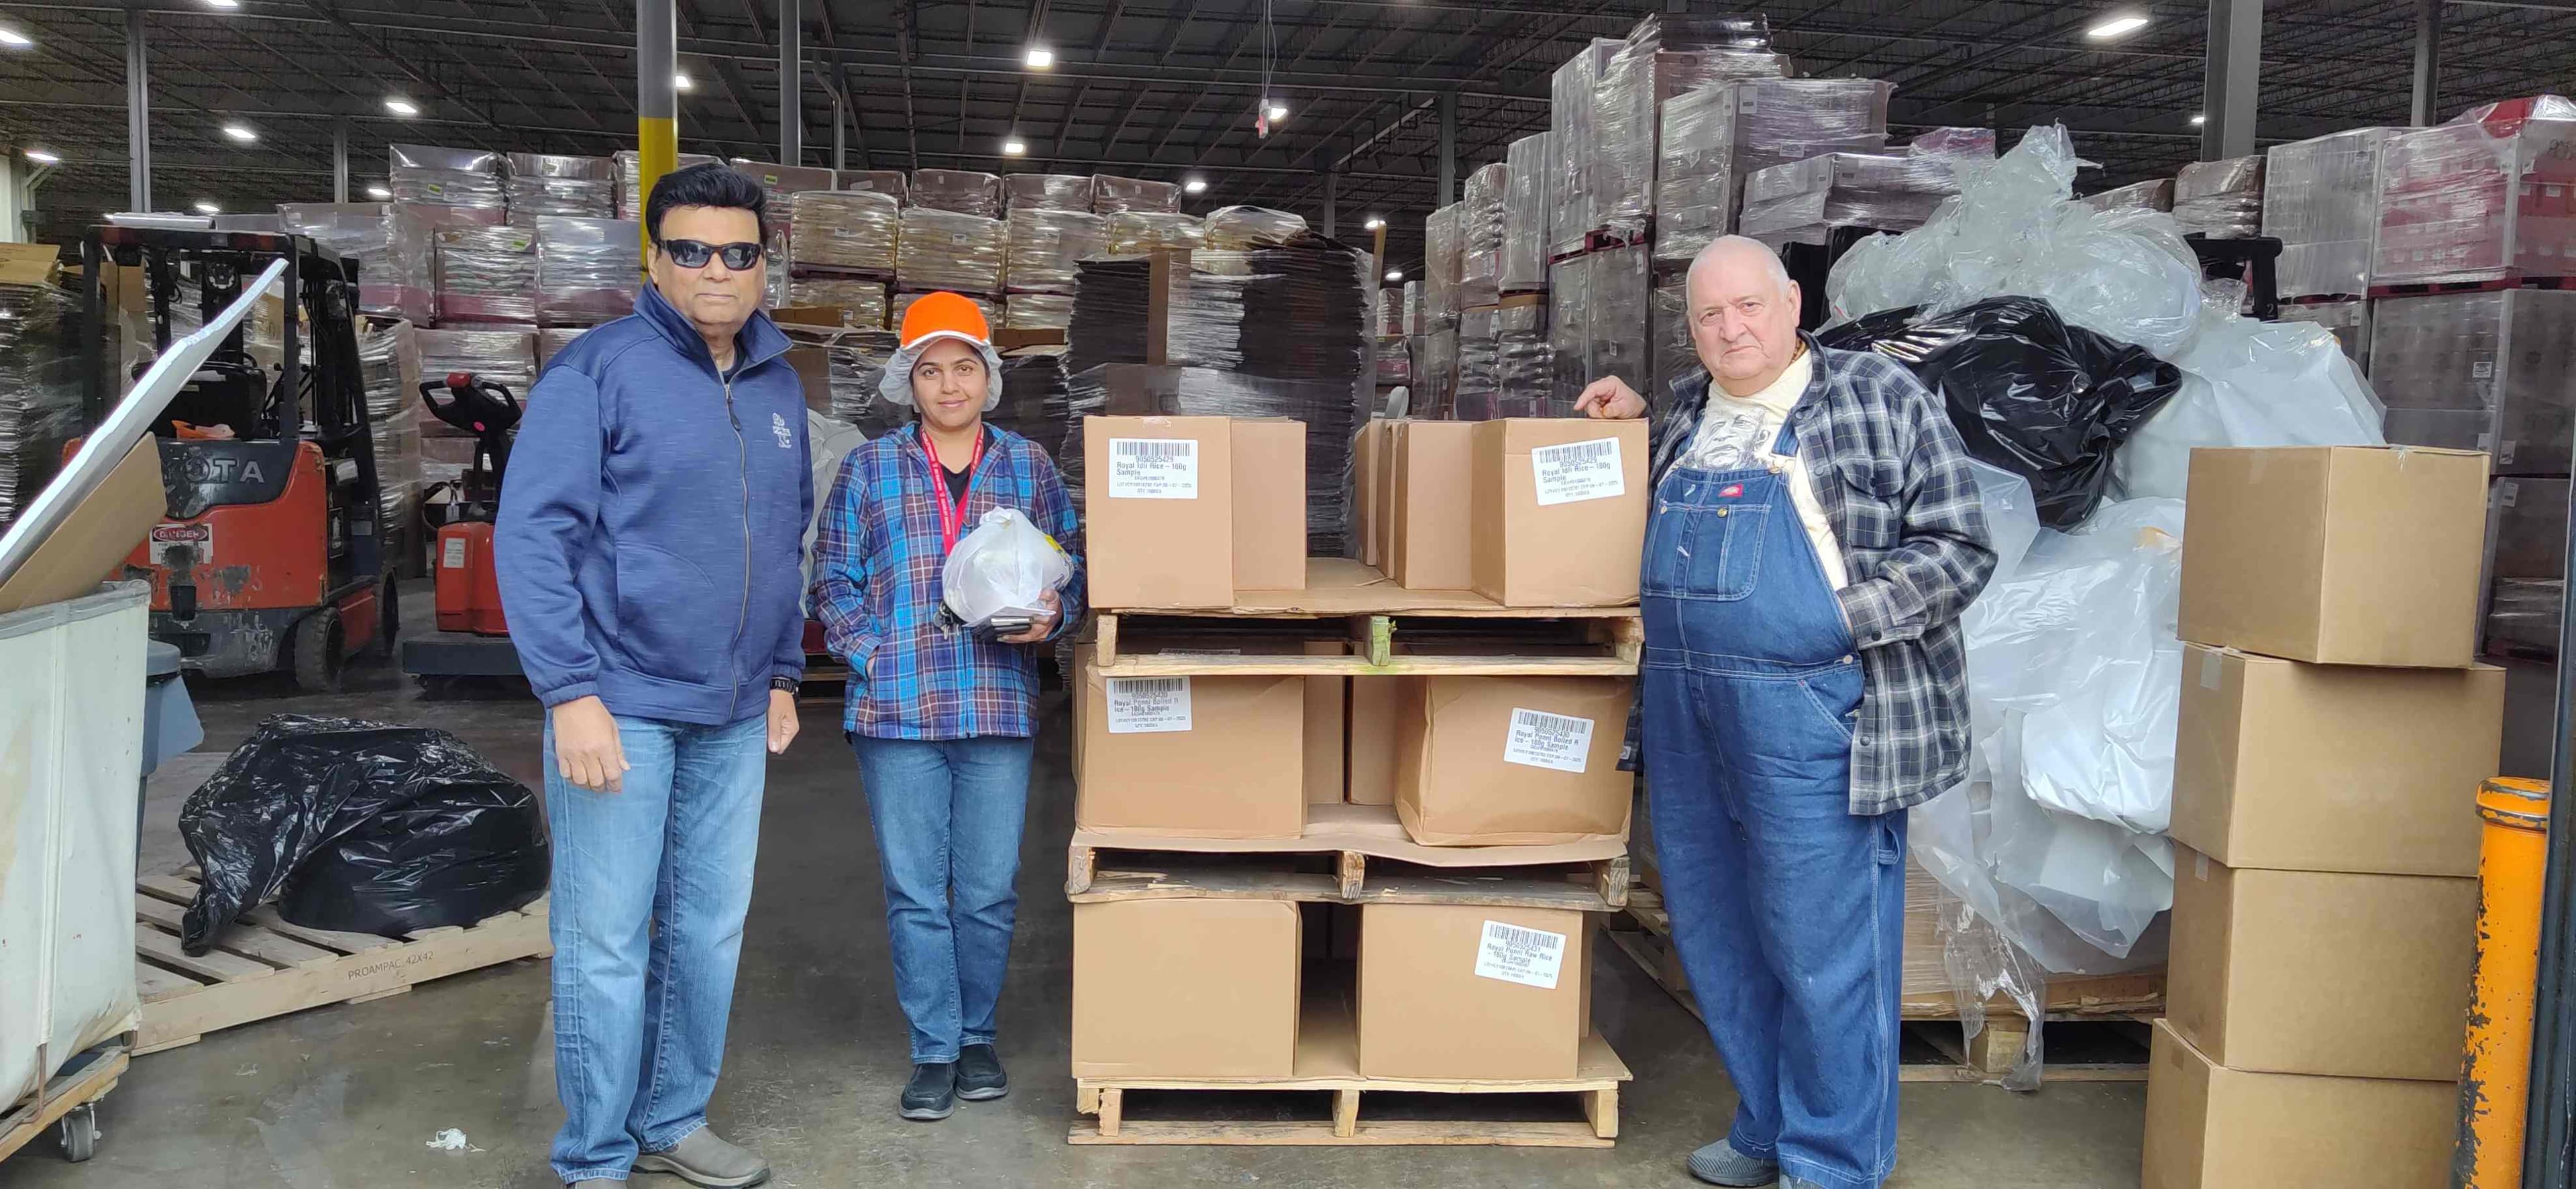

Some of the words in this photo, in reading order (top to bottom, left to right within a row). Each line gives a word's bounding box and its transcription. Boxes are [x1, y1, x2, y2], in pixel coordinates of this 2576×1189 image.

[1116, 468, 1140, 476] Sample
[1542, 468, 1560, 477] Royal
[406, 951, 434, 966] 42X42
